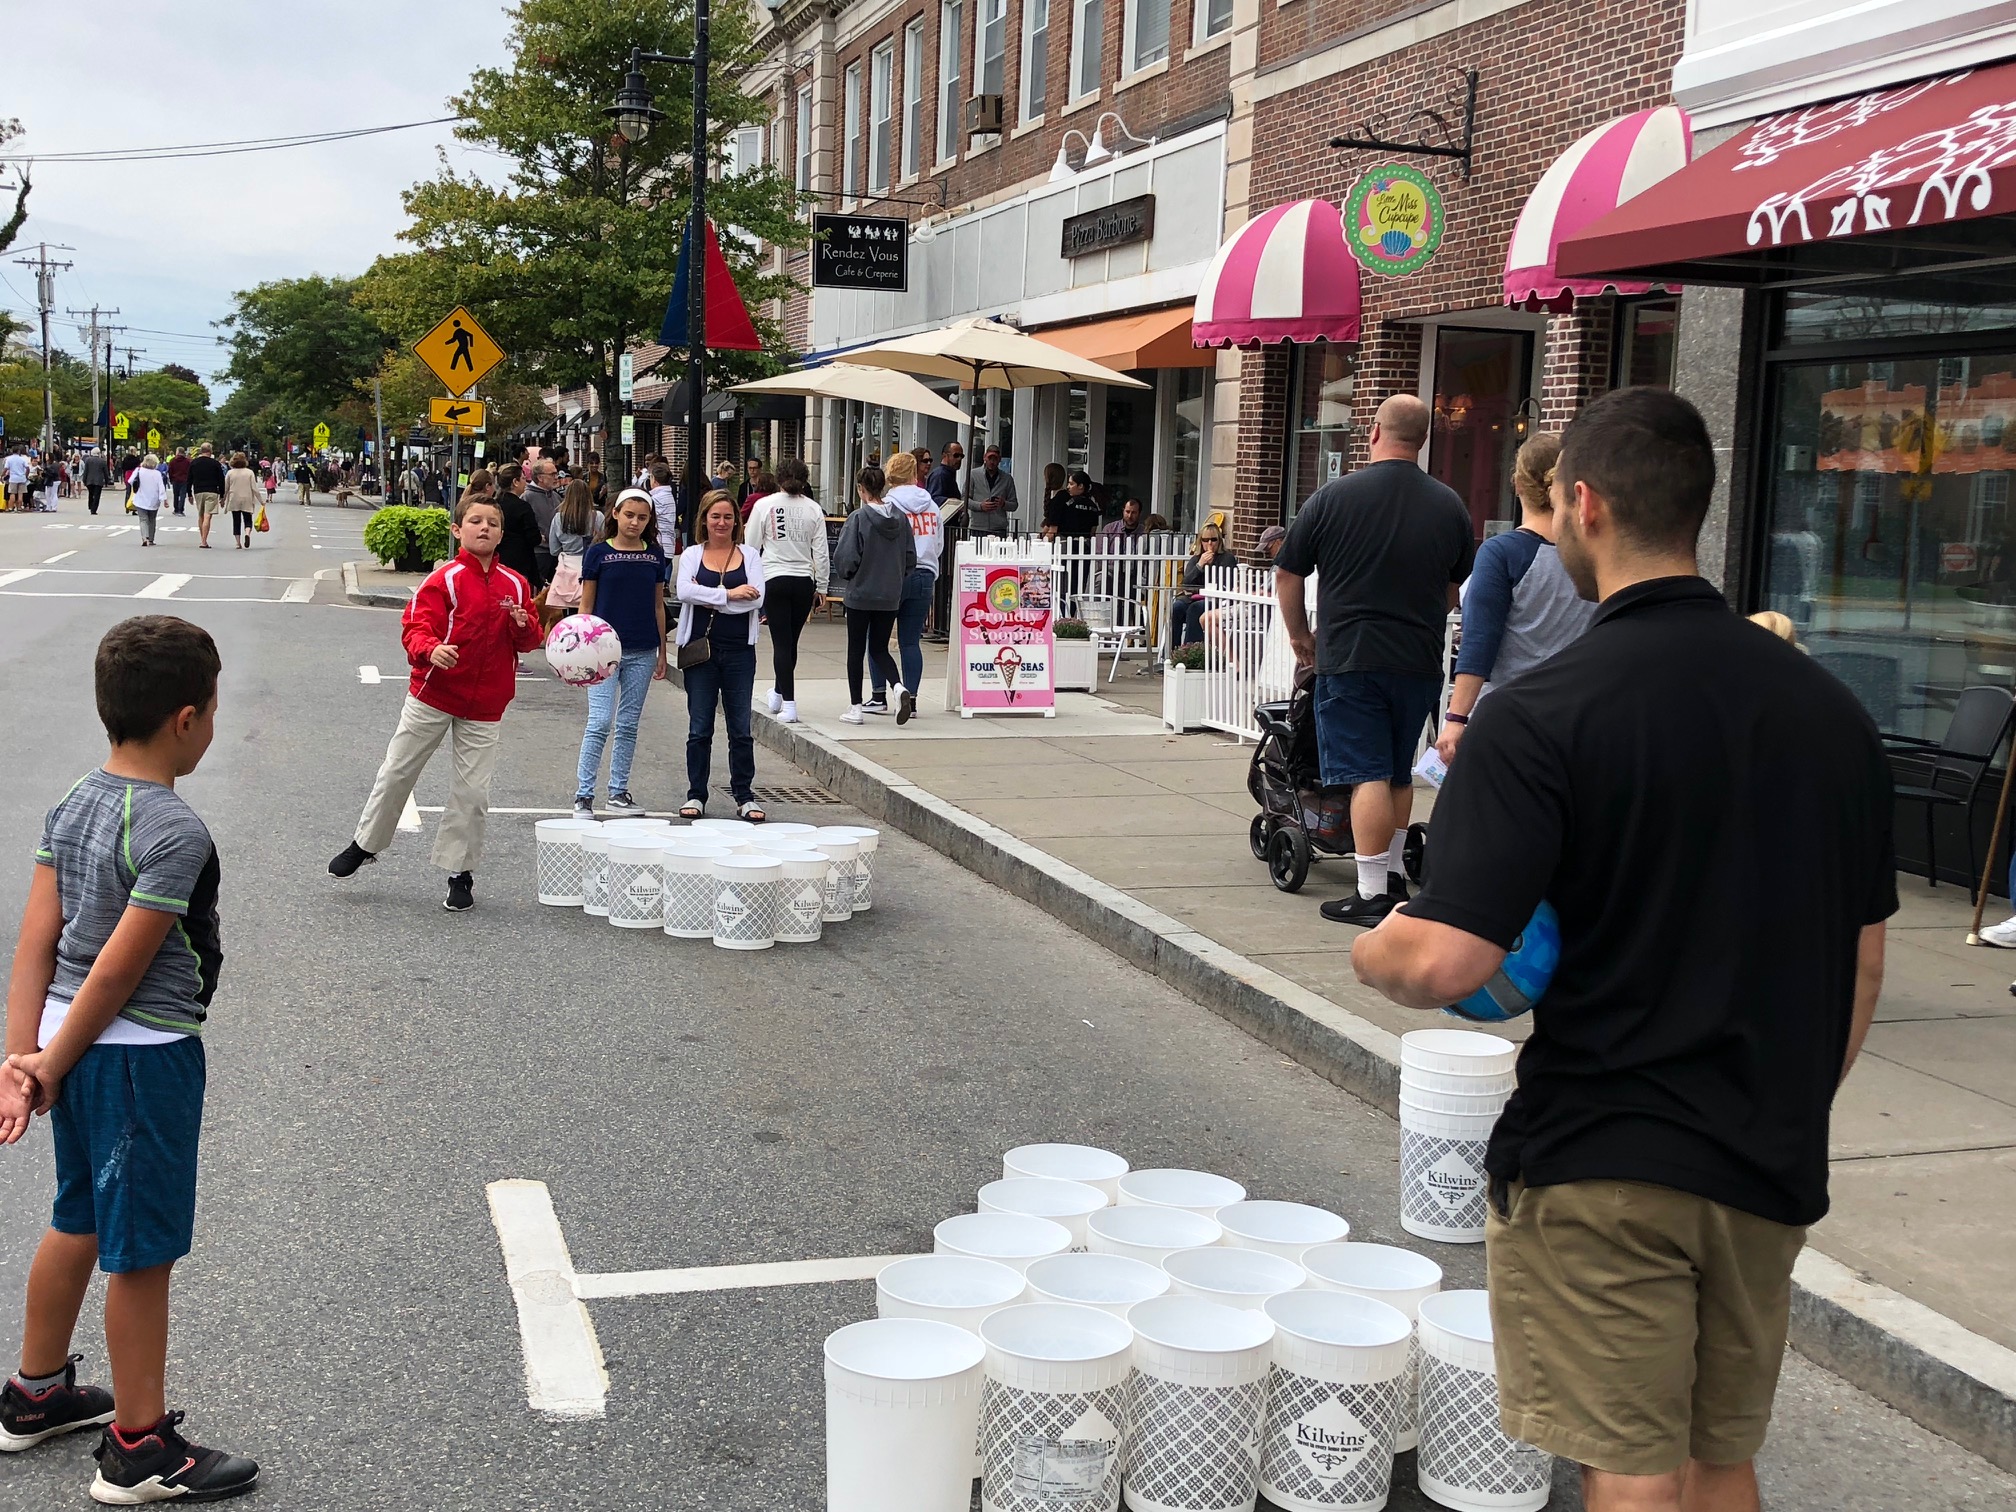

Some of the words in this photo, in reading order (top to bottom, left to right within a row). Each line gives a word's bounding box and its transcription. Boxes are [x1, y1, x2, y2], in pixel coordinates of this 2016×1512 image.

[1391, 193, 1419, 212] Miss
[1378, 206, 1419, 230] Cupcape
[1071, 223, 1096, 249] Pizza
[1097, 212, 1137, 240] Barbone
[822, 243, 865, 260] Rendez
[868, 245, 899, 262] Vous
[835, 264, 855, 277] Cafe
[856, 268, 864, 277] &
[865, 265, 899, 282] Creperie
[776, 507, 786, 539] VANS
[974, 609, 1039, 624] Proudly
[969, 629, 1045, 644] Scooping
[970, 662, 996, 672] FOUR
[1020, 662, 1044, 672] SEAS
[629, 885, 660, 893] Kilwins
[716, 902, 745, 912] Kilwins
[793, 900, 821, 909] Kilwins
[1427, 1170, 1478, 1186] Kilwins
[1296, 1421, 1367, 1446] Kilwins
